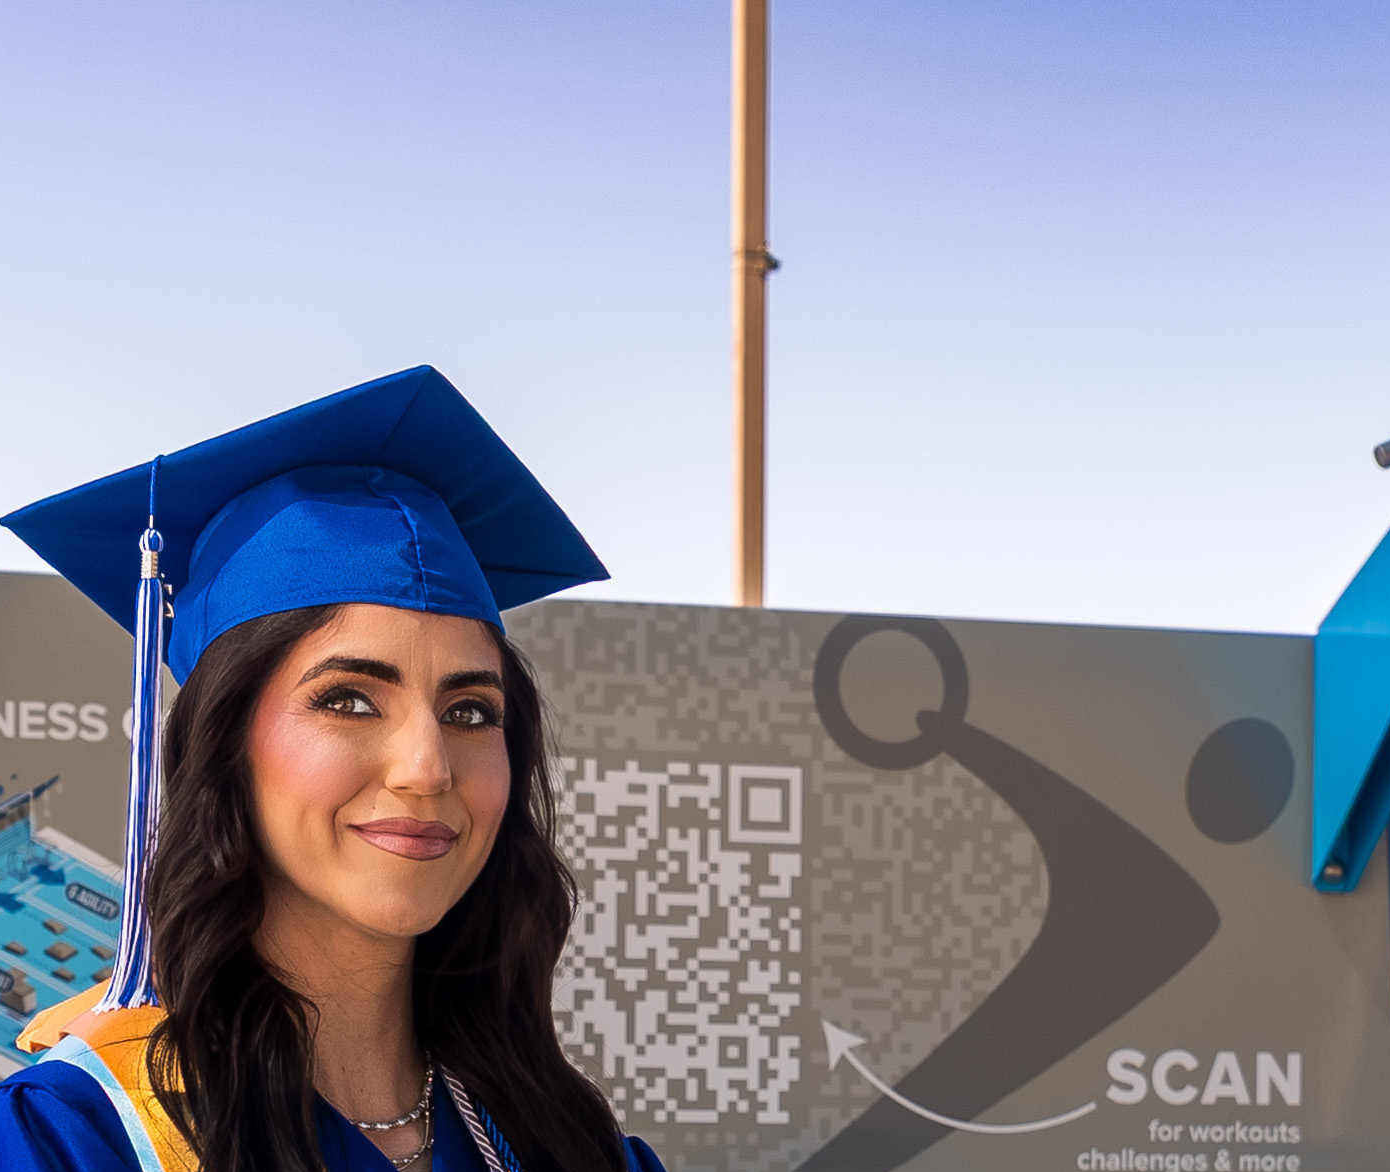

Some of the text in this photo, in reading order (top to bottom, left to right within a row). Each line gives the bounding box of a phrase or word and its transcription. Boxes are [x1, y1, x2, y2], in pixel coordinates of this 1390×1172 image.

[1105, 1047, 1303, 1107] SCAN
[1147, 1118, 1301, 1144] for workouts
[1214, 1149, 1232, 1172] &
[1238, 1152, 1301, 1172] more
